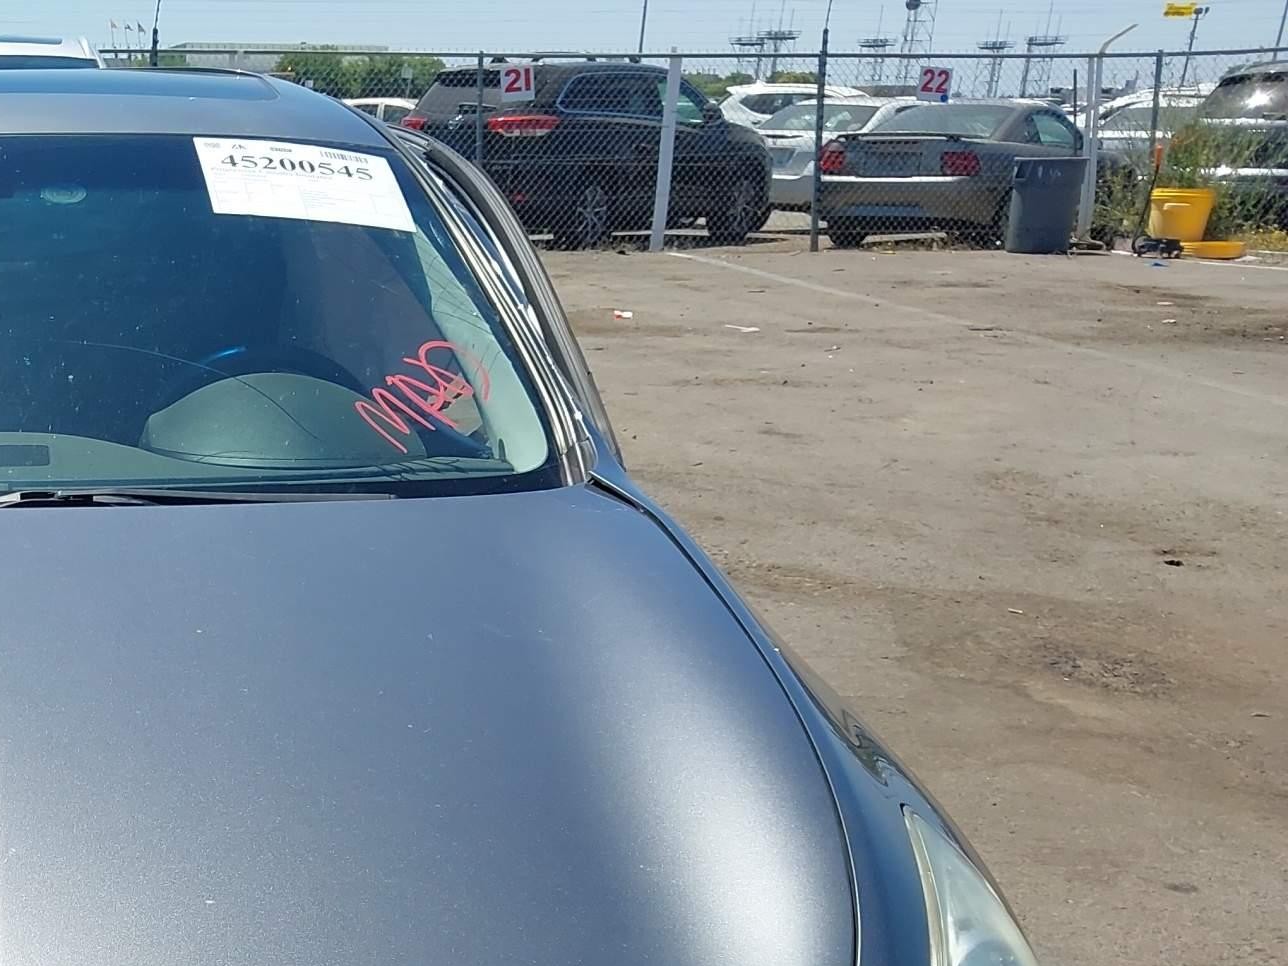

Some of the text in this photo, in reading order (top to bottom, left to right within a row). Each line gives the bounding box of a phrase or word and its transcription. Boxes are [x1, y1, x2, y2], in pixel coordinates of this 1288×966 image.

[504, 68, 531, 93] 21
[920, 69, 950, 93] 22
[220, 154, 373, 181] 45200545
